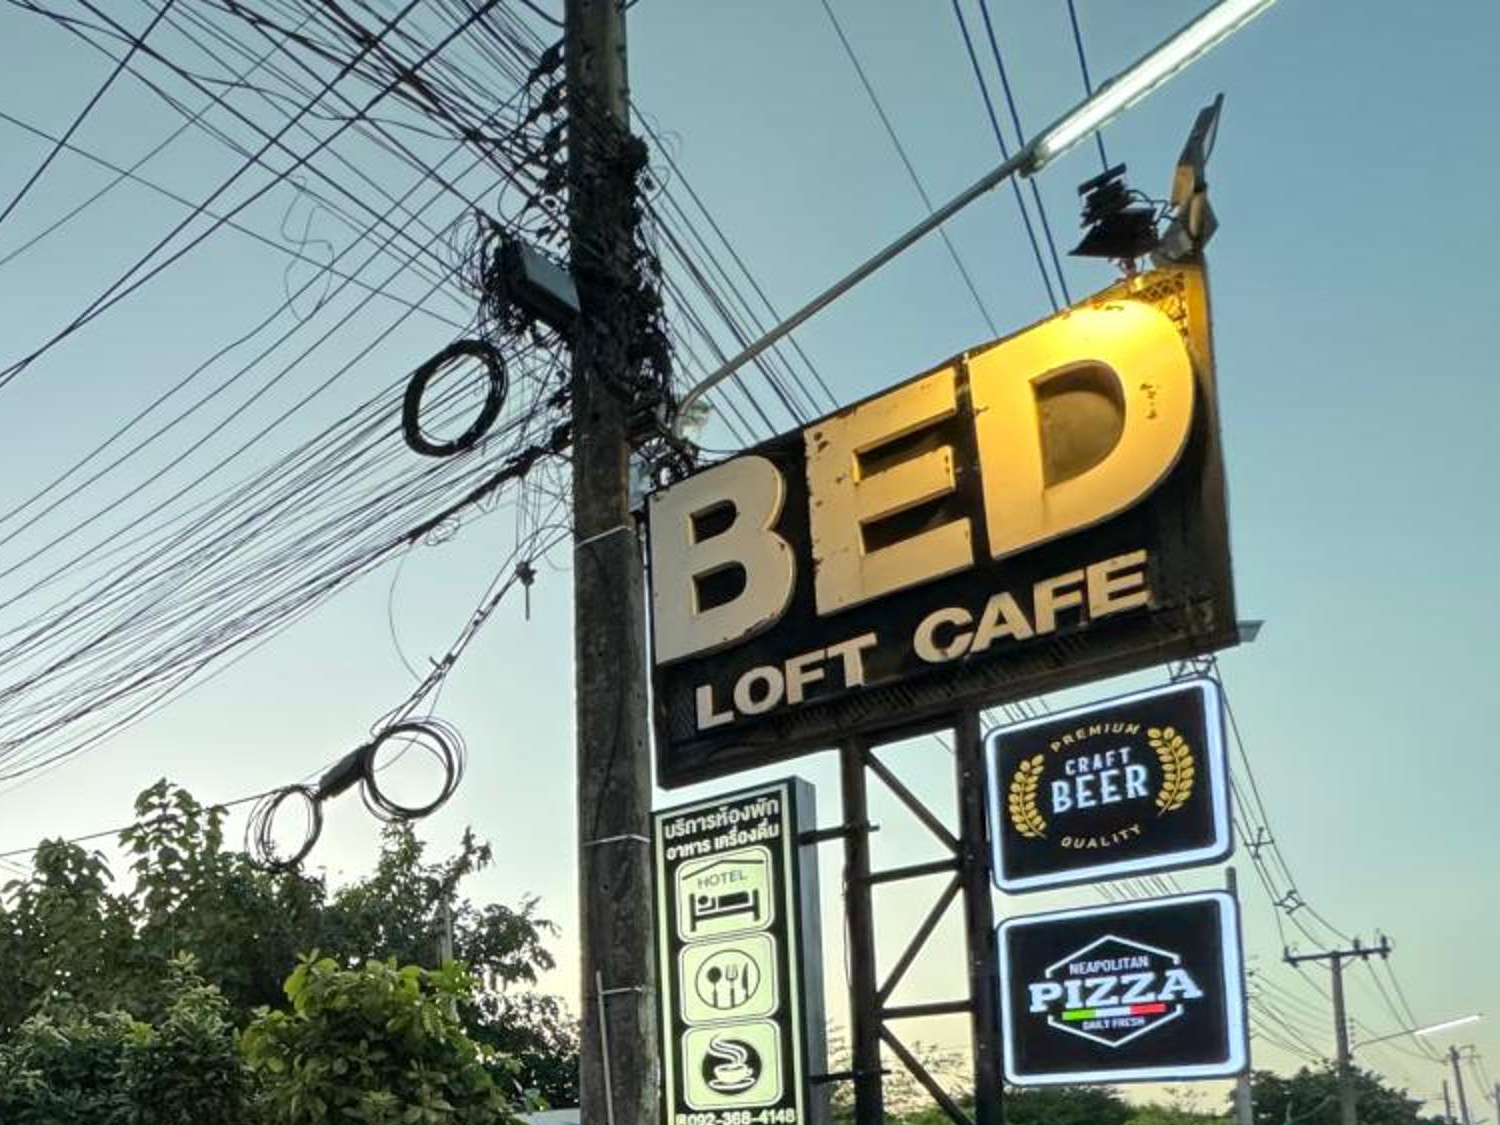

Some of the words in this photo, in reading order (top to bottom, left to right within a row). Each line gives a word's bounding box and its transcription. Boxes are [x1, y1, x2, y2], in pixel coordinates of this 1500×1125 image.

[648, 299, 1196, 666] BED
[696, 634, 878, 731] LOFT
[913, 549, 1152, 664] CAFE
[1050, 723, 1141, 753] PREMIUM
[1065, 747, 1131, 775] CRAFT
[1051, 764, 1149, 814] BEER
[665, 797, 780, 839] บริการห้องพัก
[666, 839, 712, 861] อาหาร
[1061, 824, 1141, 849] QUALITY
[697, 869, 749, 889] HOTEL
[1069, 955, 1150, 975] NEAPOLITAN
[1028, 968, 1204, 1013] PIZZA
